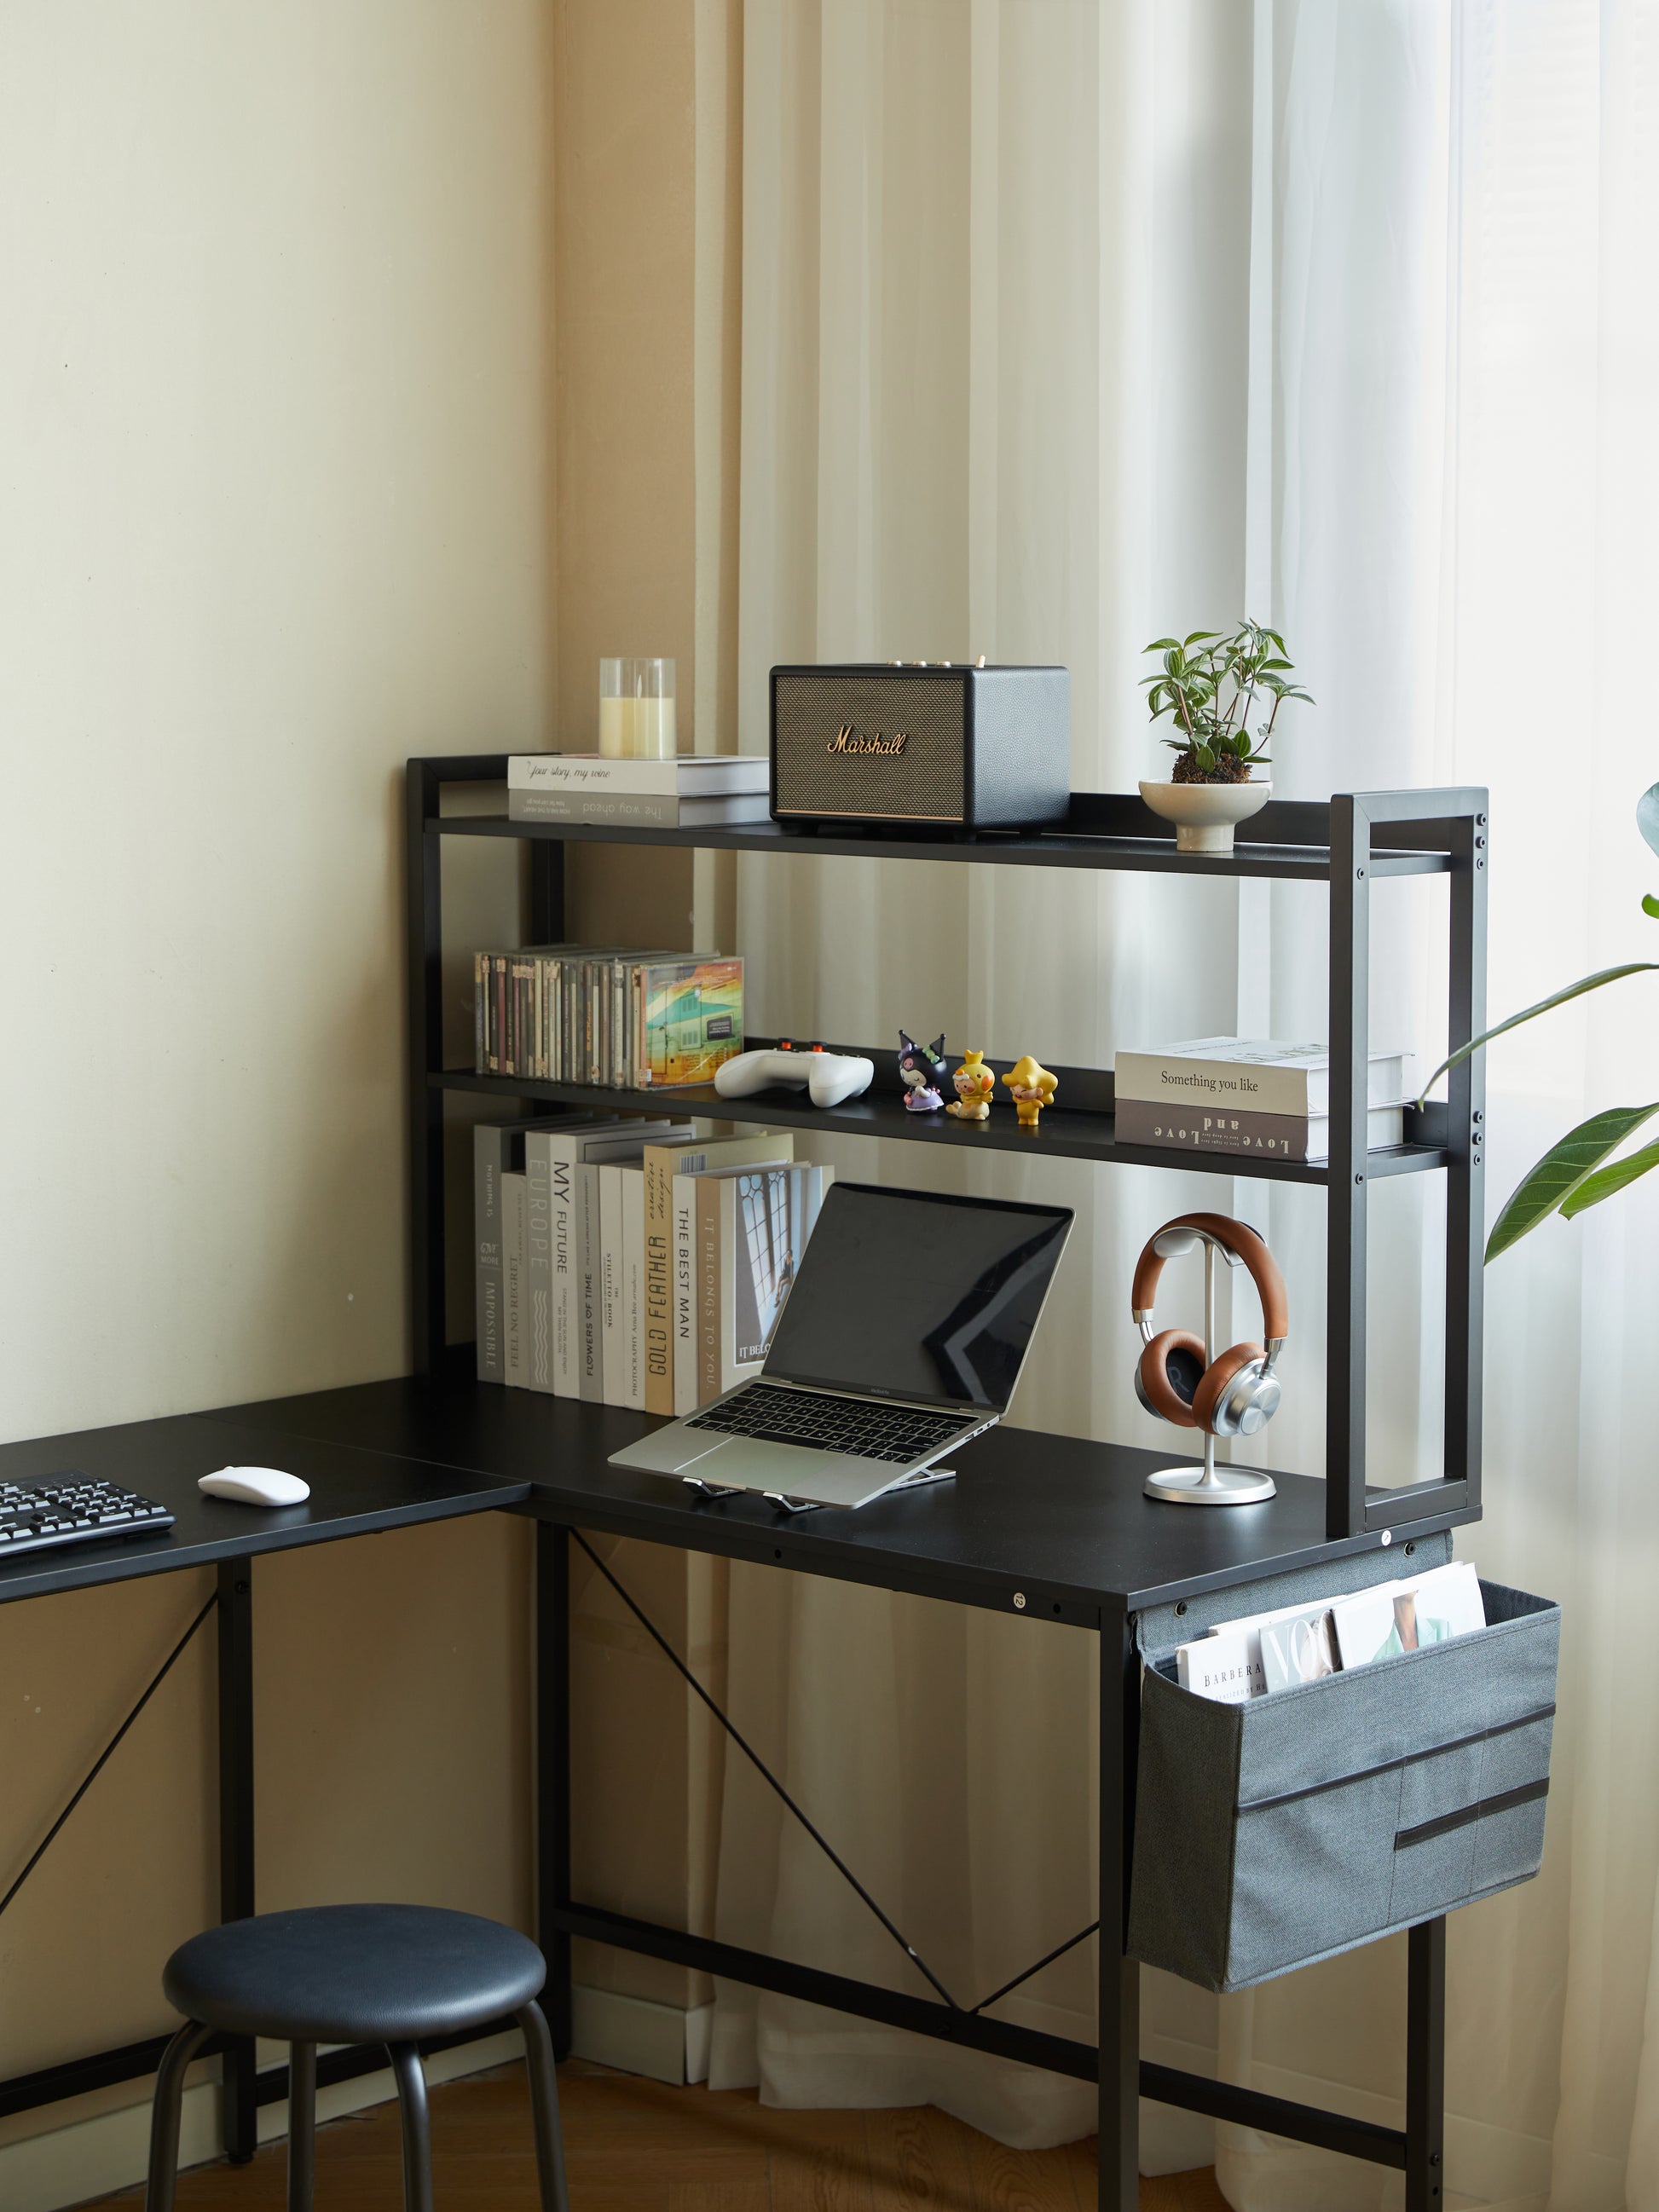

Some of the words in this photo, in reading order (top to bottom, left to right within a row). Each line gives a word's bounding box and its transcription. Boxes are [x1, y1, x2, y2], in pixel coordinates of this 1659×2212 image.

[827, 725, 907, 755] Marshall
[574, 770, 589, 782] my
[582, 802, 616, 817] ahead
[619, 802, 639, 815] way
[645, 806, 663, 820] The
[1161, 1071, 1216, 1092] Something
[1218, 1079, 1237, 1092] you
[1240, 1078, 1258, 1092] like
[1154, 1126, 1199, 1145] Love
[1204, 1118, 1240, 1131] and
[1243, 1135, 1289, 1154] Love
[554, 1162, 569, 1204] MY
[529, 1159, 548, 1268] EUROPE
[679, 1208, 689, 1241] THE
[704, 1218, 714, 1234] IT
[557, 1211, 568, 1273] FUTURE
[649, 1236, 667, 1319] FEATHER
[679, 1249, 689, 1291] BEST
[705, 1242, 715, 1317] BELONGS
[485, 1282, 496, 1369] IMPOSSIBLE
[511, 1311, 518, 1332] NO
[679, 1297, 690, 1337] MAN
[705, 1325, 715, 1345] TO
[649, 1329, 667, 1376] GOLD
[739, 1347, 749, 1359] IT
[1167, 1366, 1191, 1394] R
[1204, 1663, 1262, 1688] BARBERA
